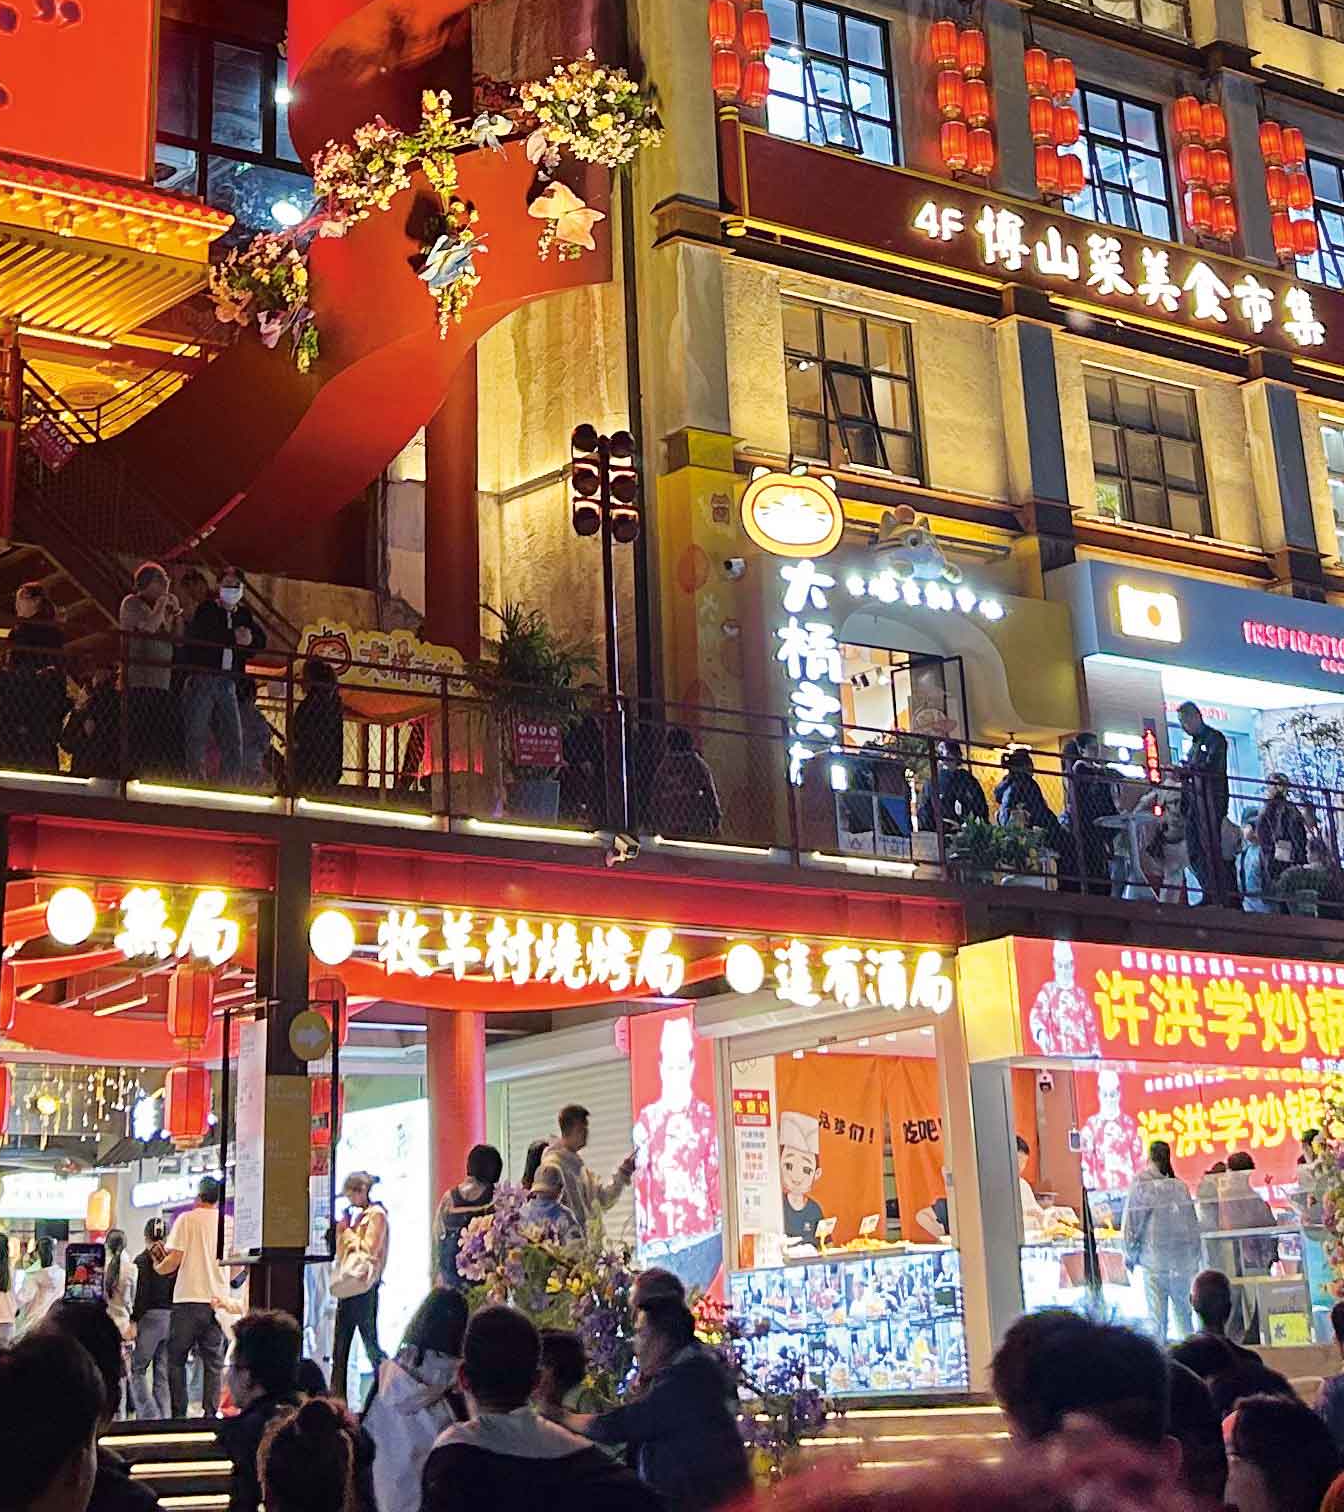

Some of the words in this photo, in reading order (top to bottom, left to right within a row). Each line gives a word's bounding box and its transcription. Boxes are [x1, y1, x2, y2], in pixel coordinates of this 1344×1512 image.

[913, 201, 964, 241] 4F
[975, 205, 1326, 346] 博山菜美食市集
